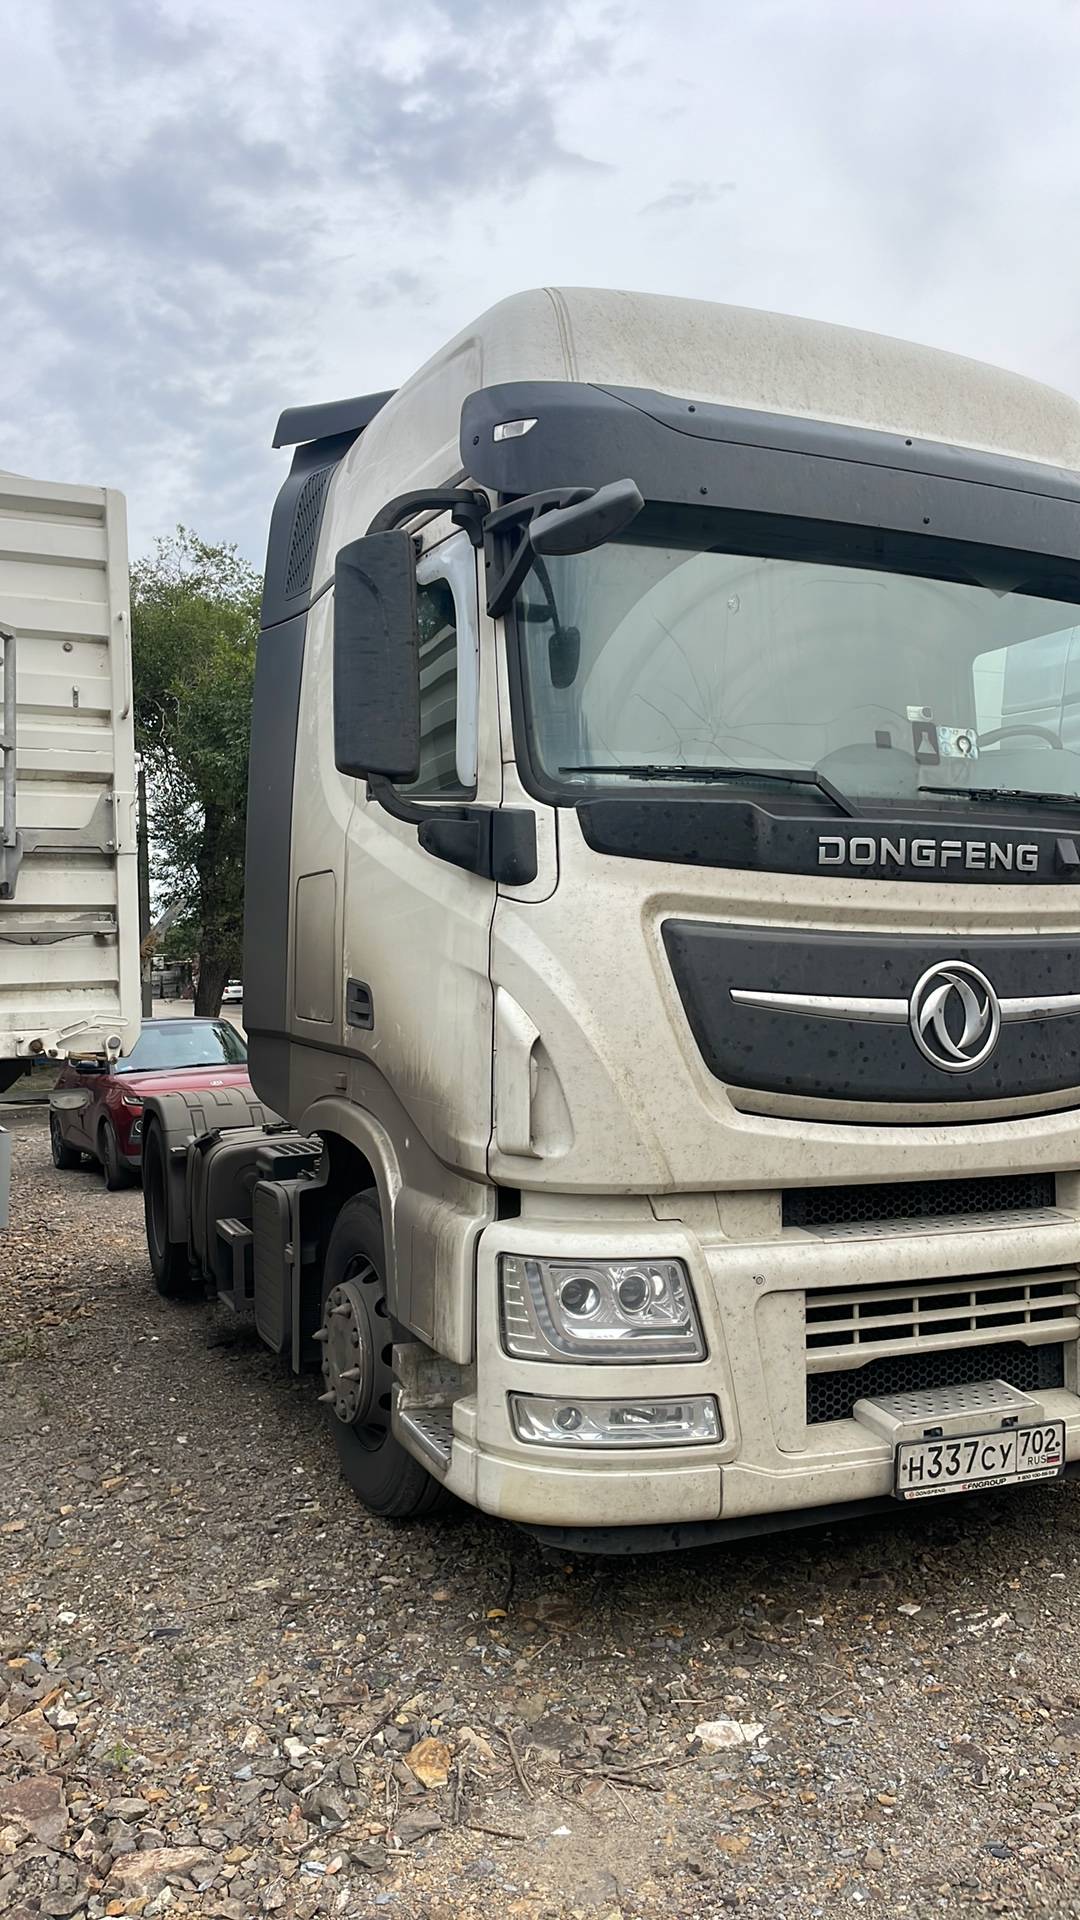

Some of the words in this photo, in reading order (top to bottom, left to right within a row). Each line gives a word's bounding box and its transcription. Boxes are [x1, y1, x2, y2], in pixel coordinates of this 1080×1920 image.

[818, 836, 1039, 872] DONGFENG
[1019, 1428, 1056, 1457] 702
[1027, 1457, 1047, 1466] RUS
